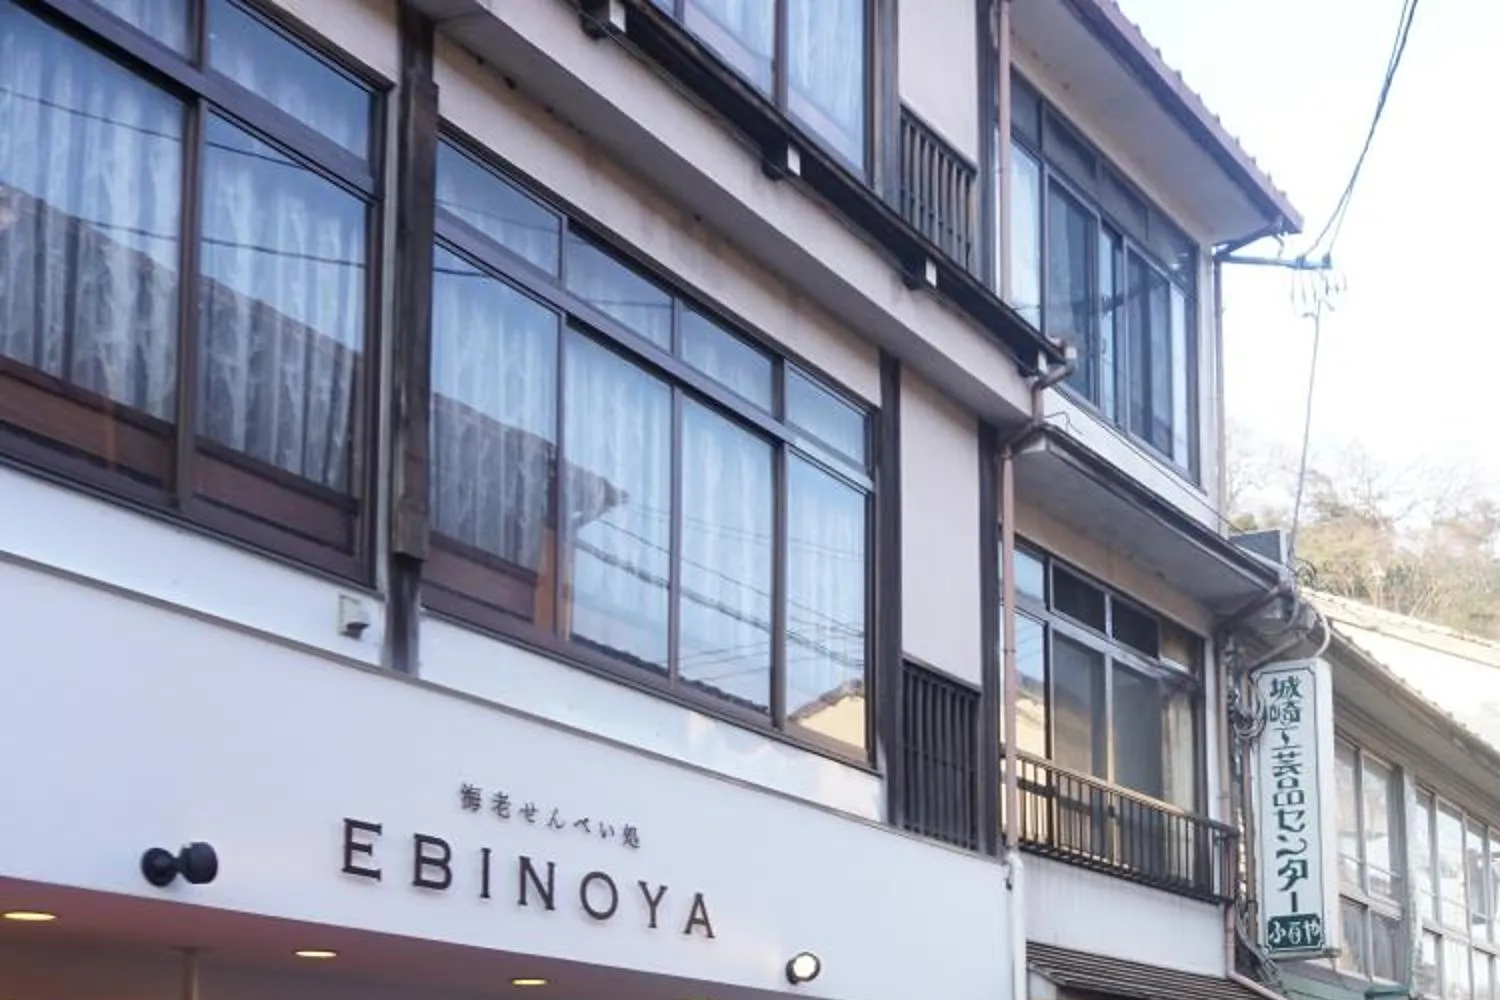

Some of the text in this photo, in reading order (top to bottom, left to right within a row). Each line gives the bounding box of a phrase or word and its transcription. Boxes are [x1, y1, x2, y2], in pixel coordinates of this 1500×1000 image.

[460, 783, 640, 849] 海老せんべい処
[341, 818, 715, 938] EBINOYA
